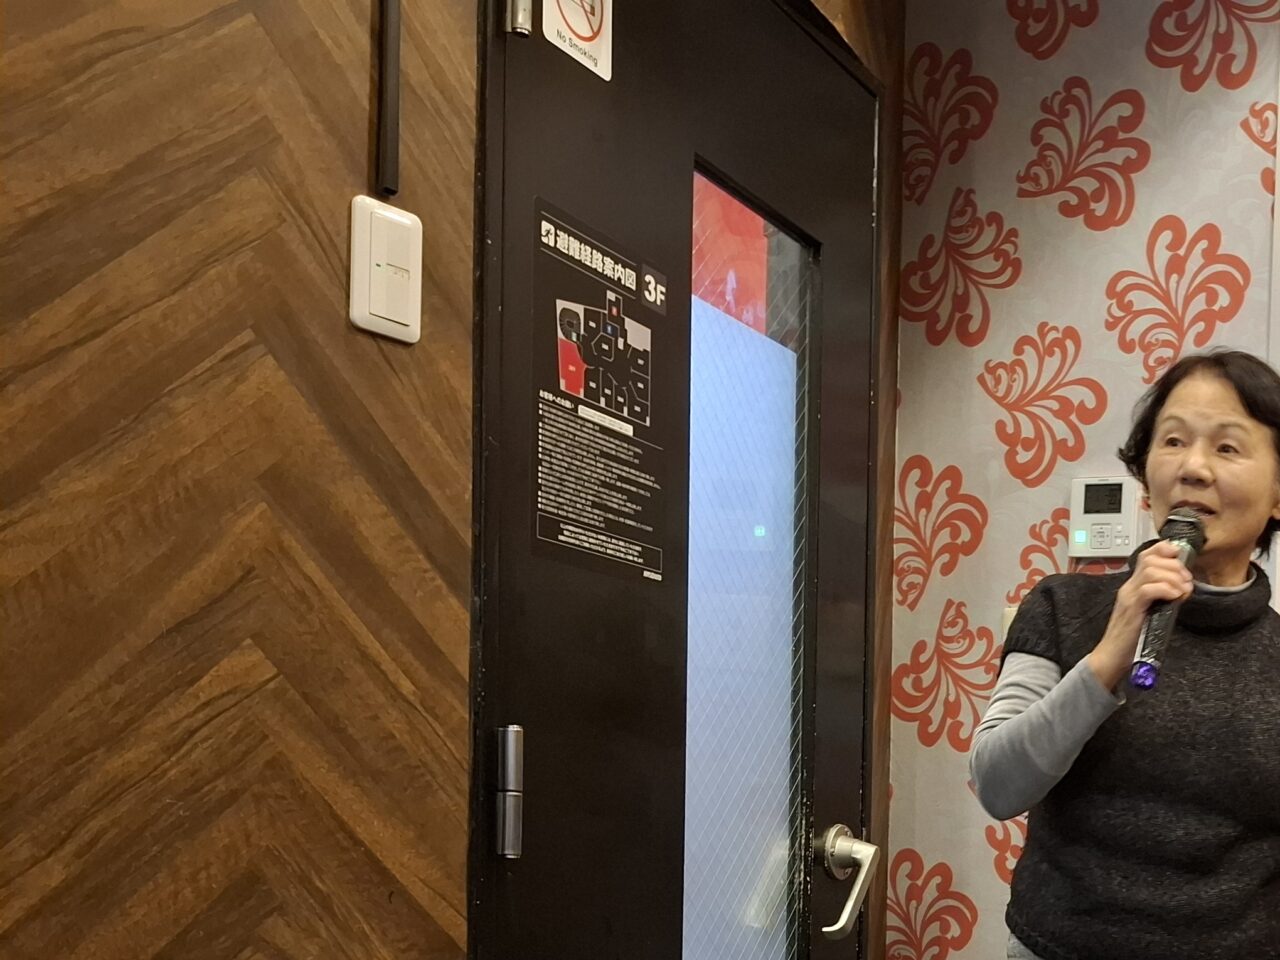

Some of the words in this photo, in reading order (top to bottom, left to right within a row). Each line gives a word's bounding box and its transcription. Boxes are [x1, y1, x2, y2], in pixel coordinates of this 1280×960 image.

[556, 28, 567, 43] No
[568, 36, 598, 68] Smoking
[556, 229, 636, 291] 避難経路案内図
[643, 274, 666, 306] 3F
